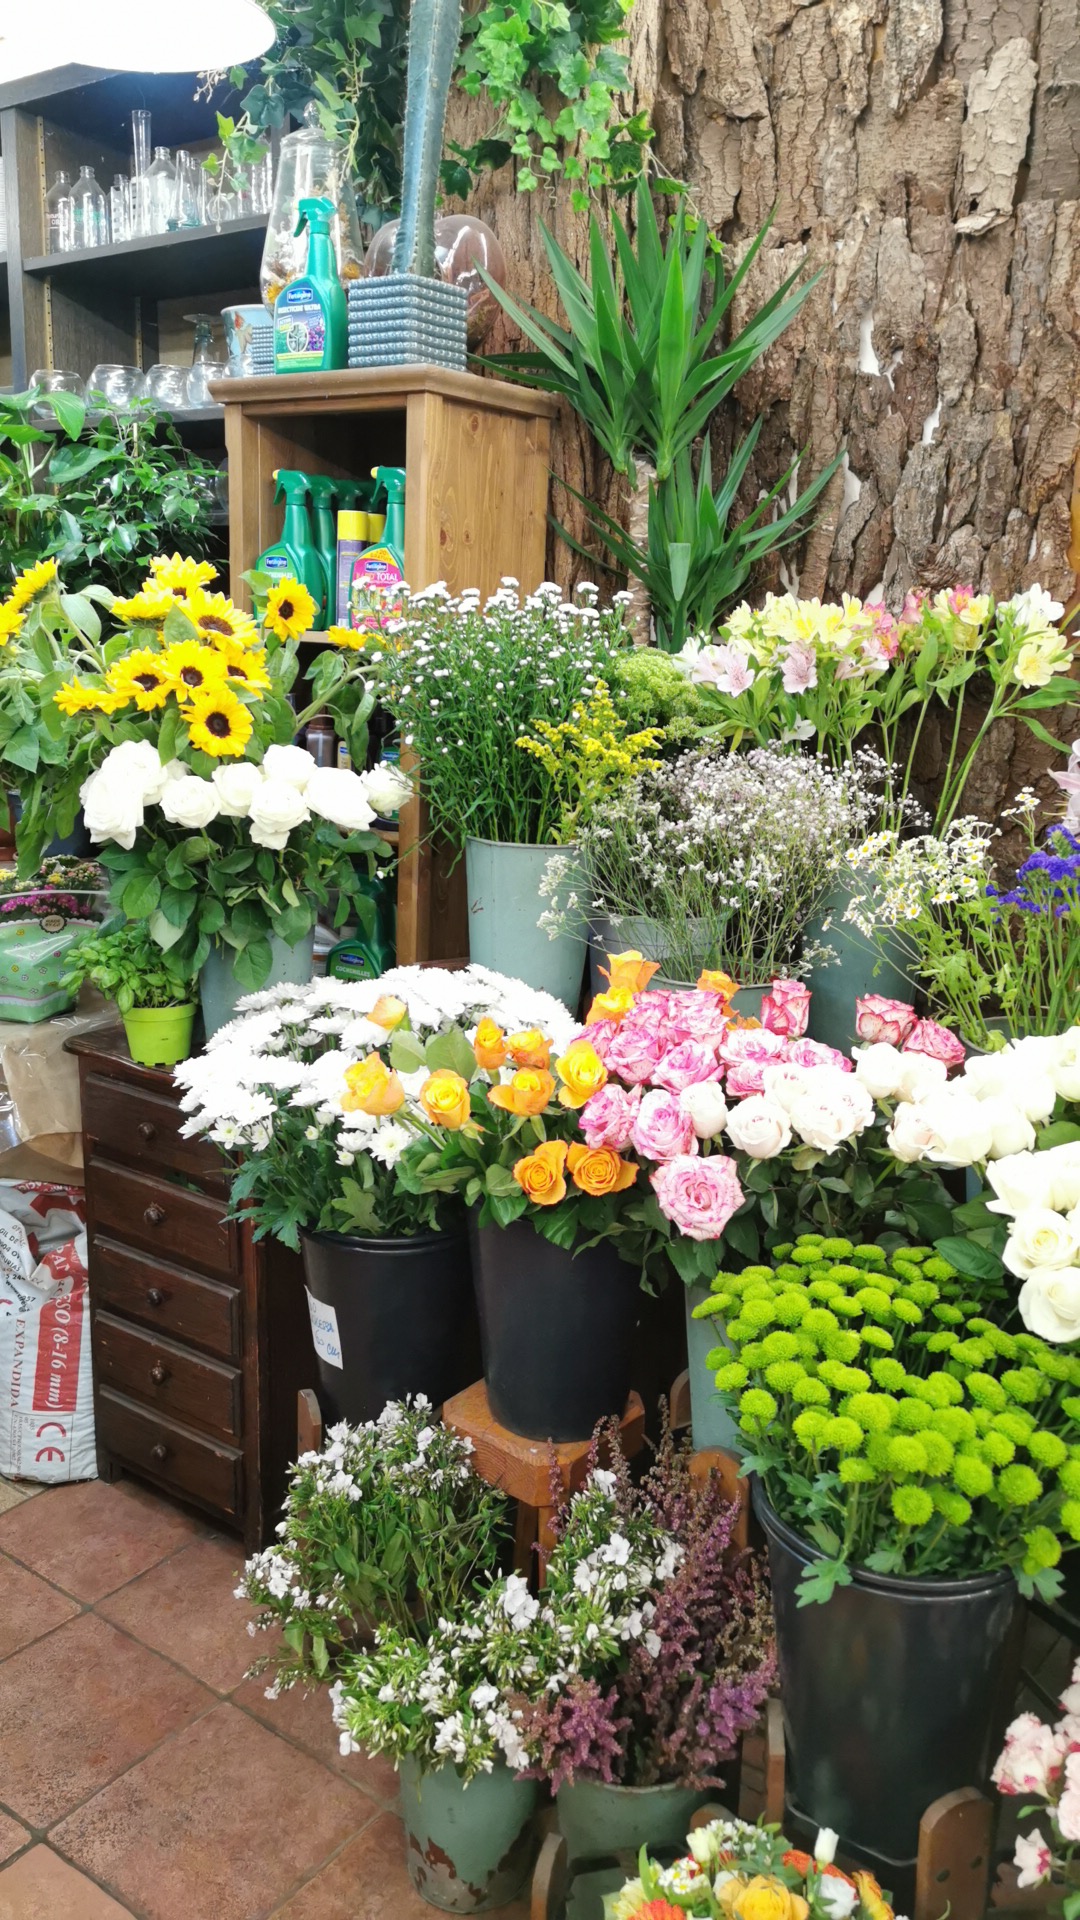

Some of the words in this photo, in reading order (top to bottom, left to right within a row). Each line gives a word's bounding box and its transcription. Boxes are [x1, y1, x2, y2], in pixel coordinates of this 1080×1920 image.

[304, 303, 321, 311] ULTRA
[377, 573, 397, 581] TOTAL
[336, 966, 370, 977] COCHENILLES
[9, 1235, 20, 1244] DE
[50, 1327, 70, 1369] (8-16
[10, 1319, 26, 1408] EXPANDIDA
[45, 1374, 64, 1409] mm)
[35, 1421, 67, 1463] CE
